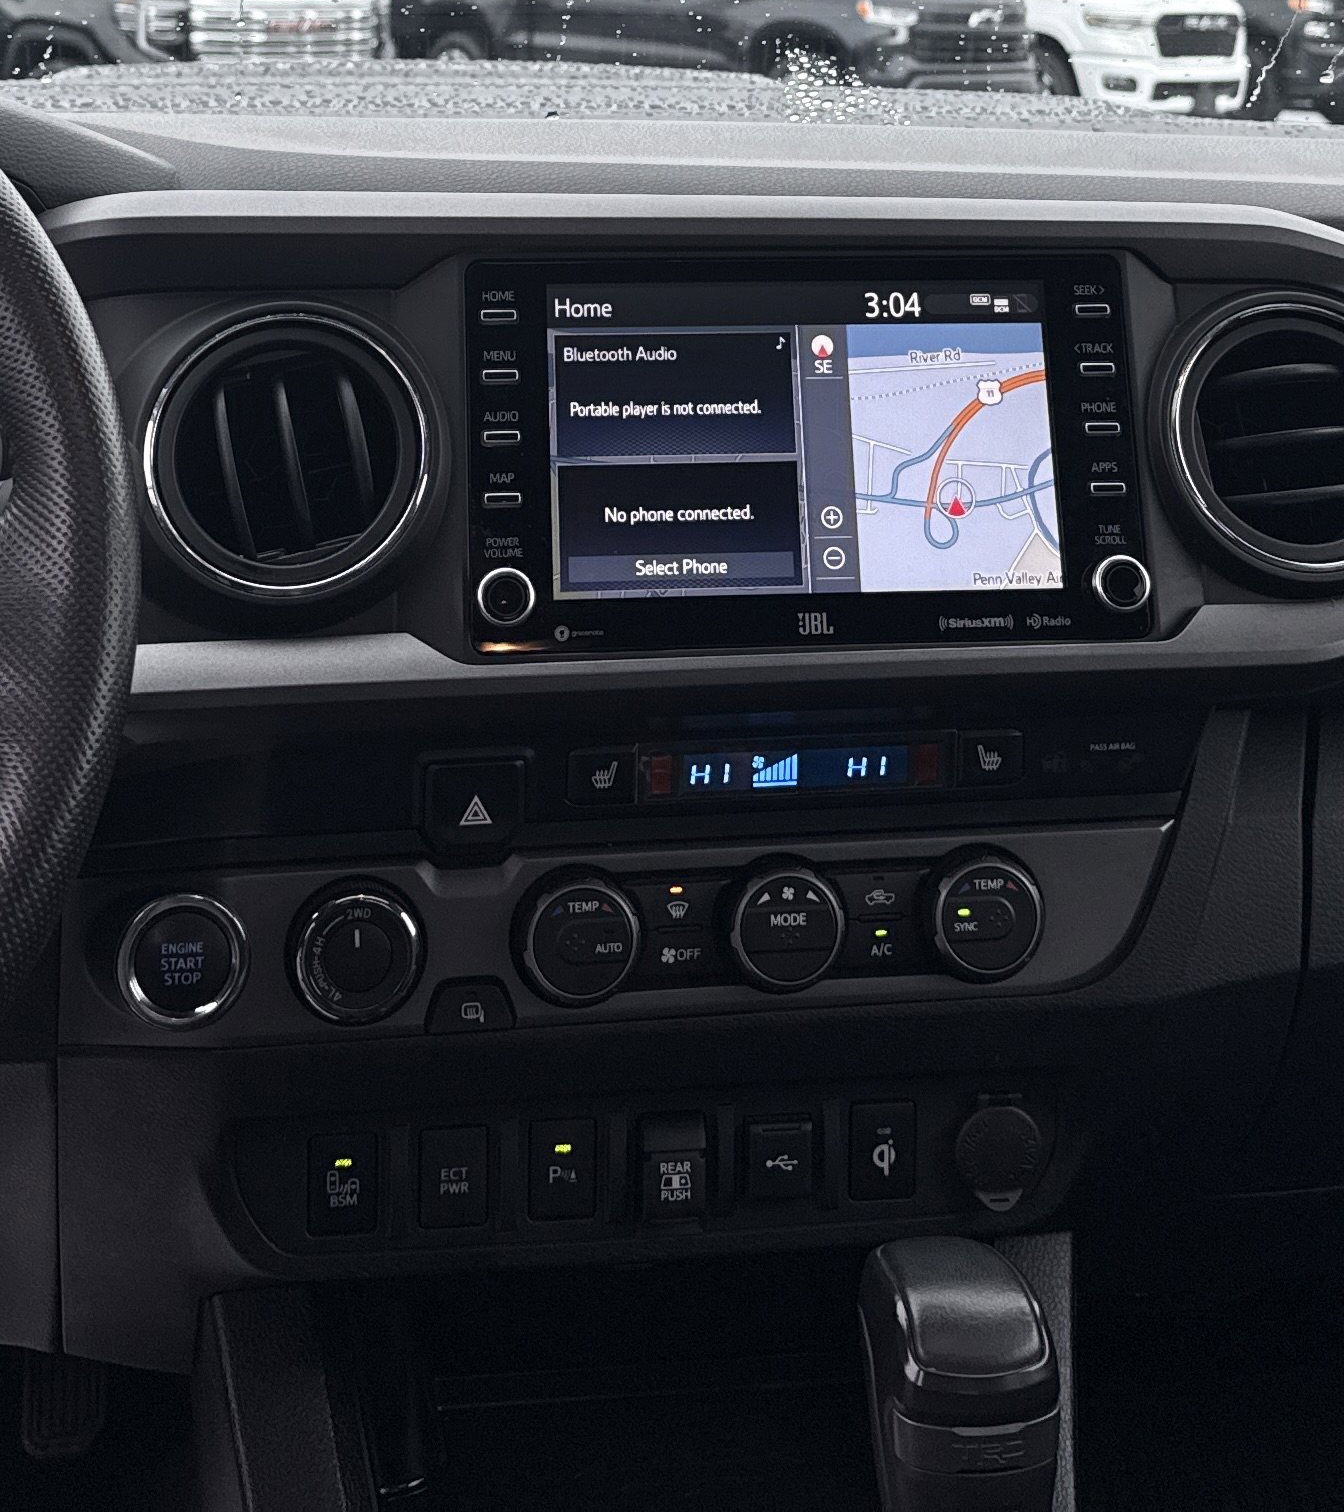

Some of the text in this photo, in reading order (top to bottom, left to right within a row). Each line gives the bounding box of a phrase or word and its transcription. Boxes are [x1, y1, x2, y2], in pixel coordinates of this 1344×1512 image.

[482, 290, 516, 303] HOME
[554, 297, 613, 318] Home
[863, 291, 922, 319] 3:04
[483, 350, 517, 362] MENU
[562, 345, 678, 362] Bluetooth Audio
[909, 348, 962, 365] River Rd
[814, 359, 833, 375] SE
[569, 398, 762, 419] Portable player is not connected.
[1080, 401, 1118, 414] PHONE
[483, 410, 520, 422] AUDIO
[1090, 461, 1119, 473] APPS
[488, 472, 516, 484] MAP
[604, 503, 755, 526] No phone connected.
[1097, 524, 1122, 535] TUNE
[485, 537, 521, 548] POWER
[1094, 535, 1127, 545] SCROLL
[483, 548, 524, 559] VOLUME
[635, 557, 729, 576] Select Phone
[972, 572, 1003, 586] Penn
[1005, 571, 1042, 587] Valley
[797, 612, 835, 636] JBL
[1042, 615, 1072, 627] Radio
[1089, 741, 1137, 752] PASS AIR BAG
[972, 877, 1006, 892] TEMP
[345, 906, 372, 921] 2WD
[567, 899, 601, 915] TEMP
[769, 912, 808, 928] MODE
[953, 920, 979, 934] SYNC
[160, 940, 205, 956] ENGINE
[594, 941, 624, 955] AUTO
[675, 946, 703, 962] OFF
[869, 942, 893, 958] A/C
[160, 956, 205, 971] START
[163, 971, 203, 986] STOP
[440, 1166, 468, 1182] ECT
[660, 1161, 692, 1175] REAR
[439, 1181, 470, 1195] PWR
[660, 1189, 692, 1202] PUSH
[329, 1194, 359, 1208] BSM
